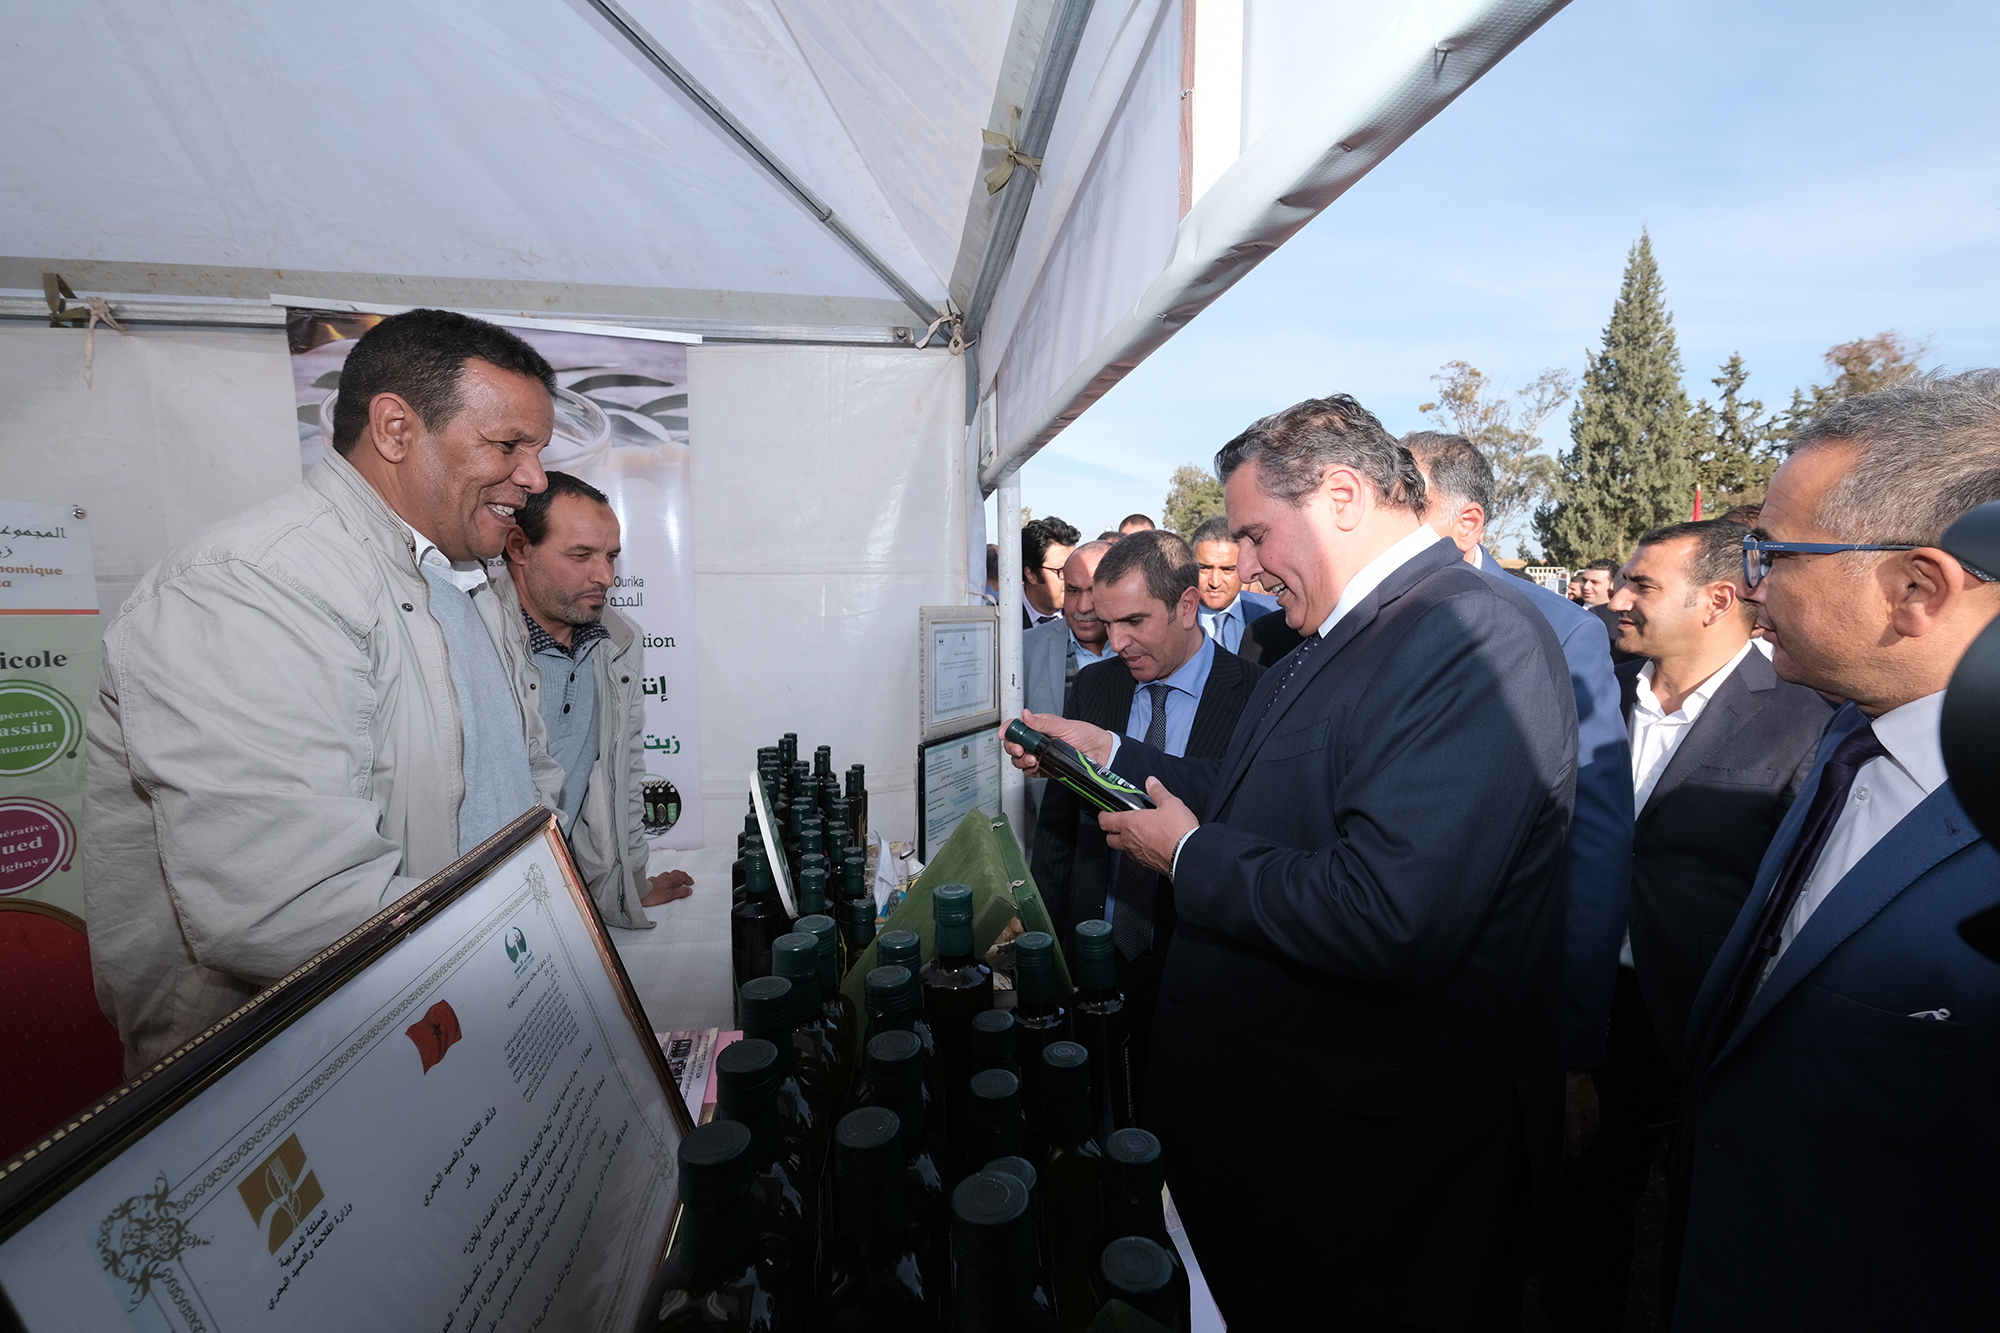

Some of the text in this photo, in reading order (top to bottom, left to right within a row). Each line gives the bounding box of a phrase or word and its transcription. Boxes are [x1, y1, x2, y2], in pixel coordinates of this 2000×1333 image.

[0, 525, 67, 540] المجموع
[613, 575, 644, 588] Ourika
[605, 592, 643, 610] المجم
[643, 734, 681, 755] زيت
[0, 836, 43, 855] ued
[462, 1122, 482, 1147] الفلاحة
[529, 1132, 543, 1159] الزيتون
[444, 1148, 464, 1175] والصيد
[520, 1155, 529, 1176] البكر
[466, 1163, 481, 1189] يقرر
[498, 1172, 518, 1203] الممتازة
[424, 1172, 443, 1207] البحري
[504, 1206, 521, 1227] بجهة
[278, 1210, 328, 1268] المملكة المغربية
[488, 1228, 507, 1261] مراكش
[517, 1215, 535, 1249] الزيتون
[269, 1203, 353, 1310] وزارة الفلاحة والصيد البحري
[506, 1245, 517, 1271] البكر
[460, 1264, 482, 1304] تانسيفت
[481, 1267, 504, 1305] الممتازة
